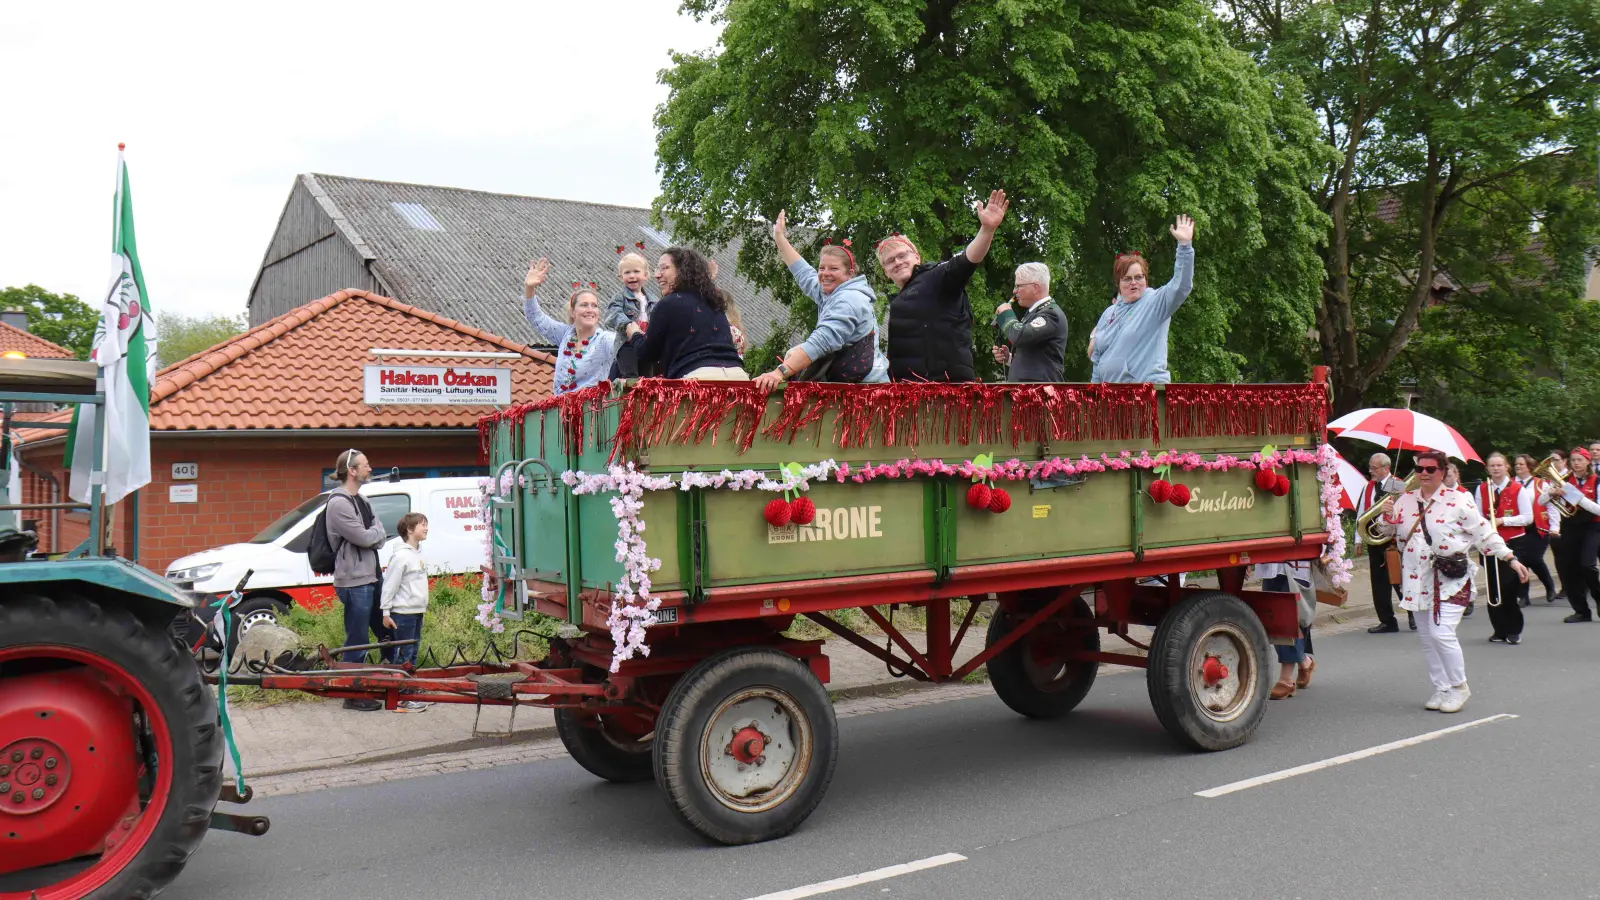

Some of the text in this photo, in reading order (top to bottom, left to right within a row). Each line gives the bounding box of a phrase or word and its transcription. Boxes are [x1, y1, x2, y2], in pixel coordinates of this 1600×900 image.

[380, 368, 497, 387] Hakan Özkan
[411, 387, 442, 395] Heizung
[445, 387, 474, 395] Lüftung
[1185, 486, 1255, 513] Emsland
